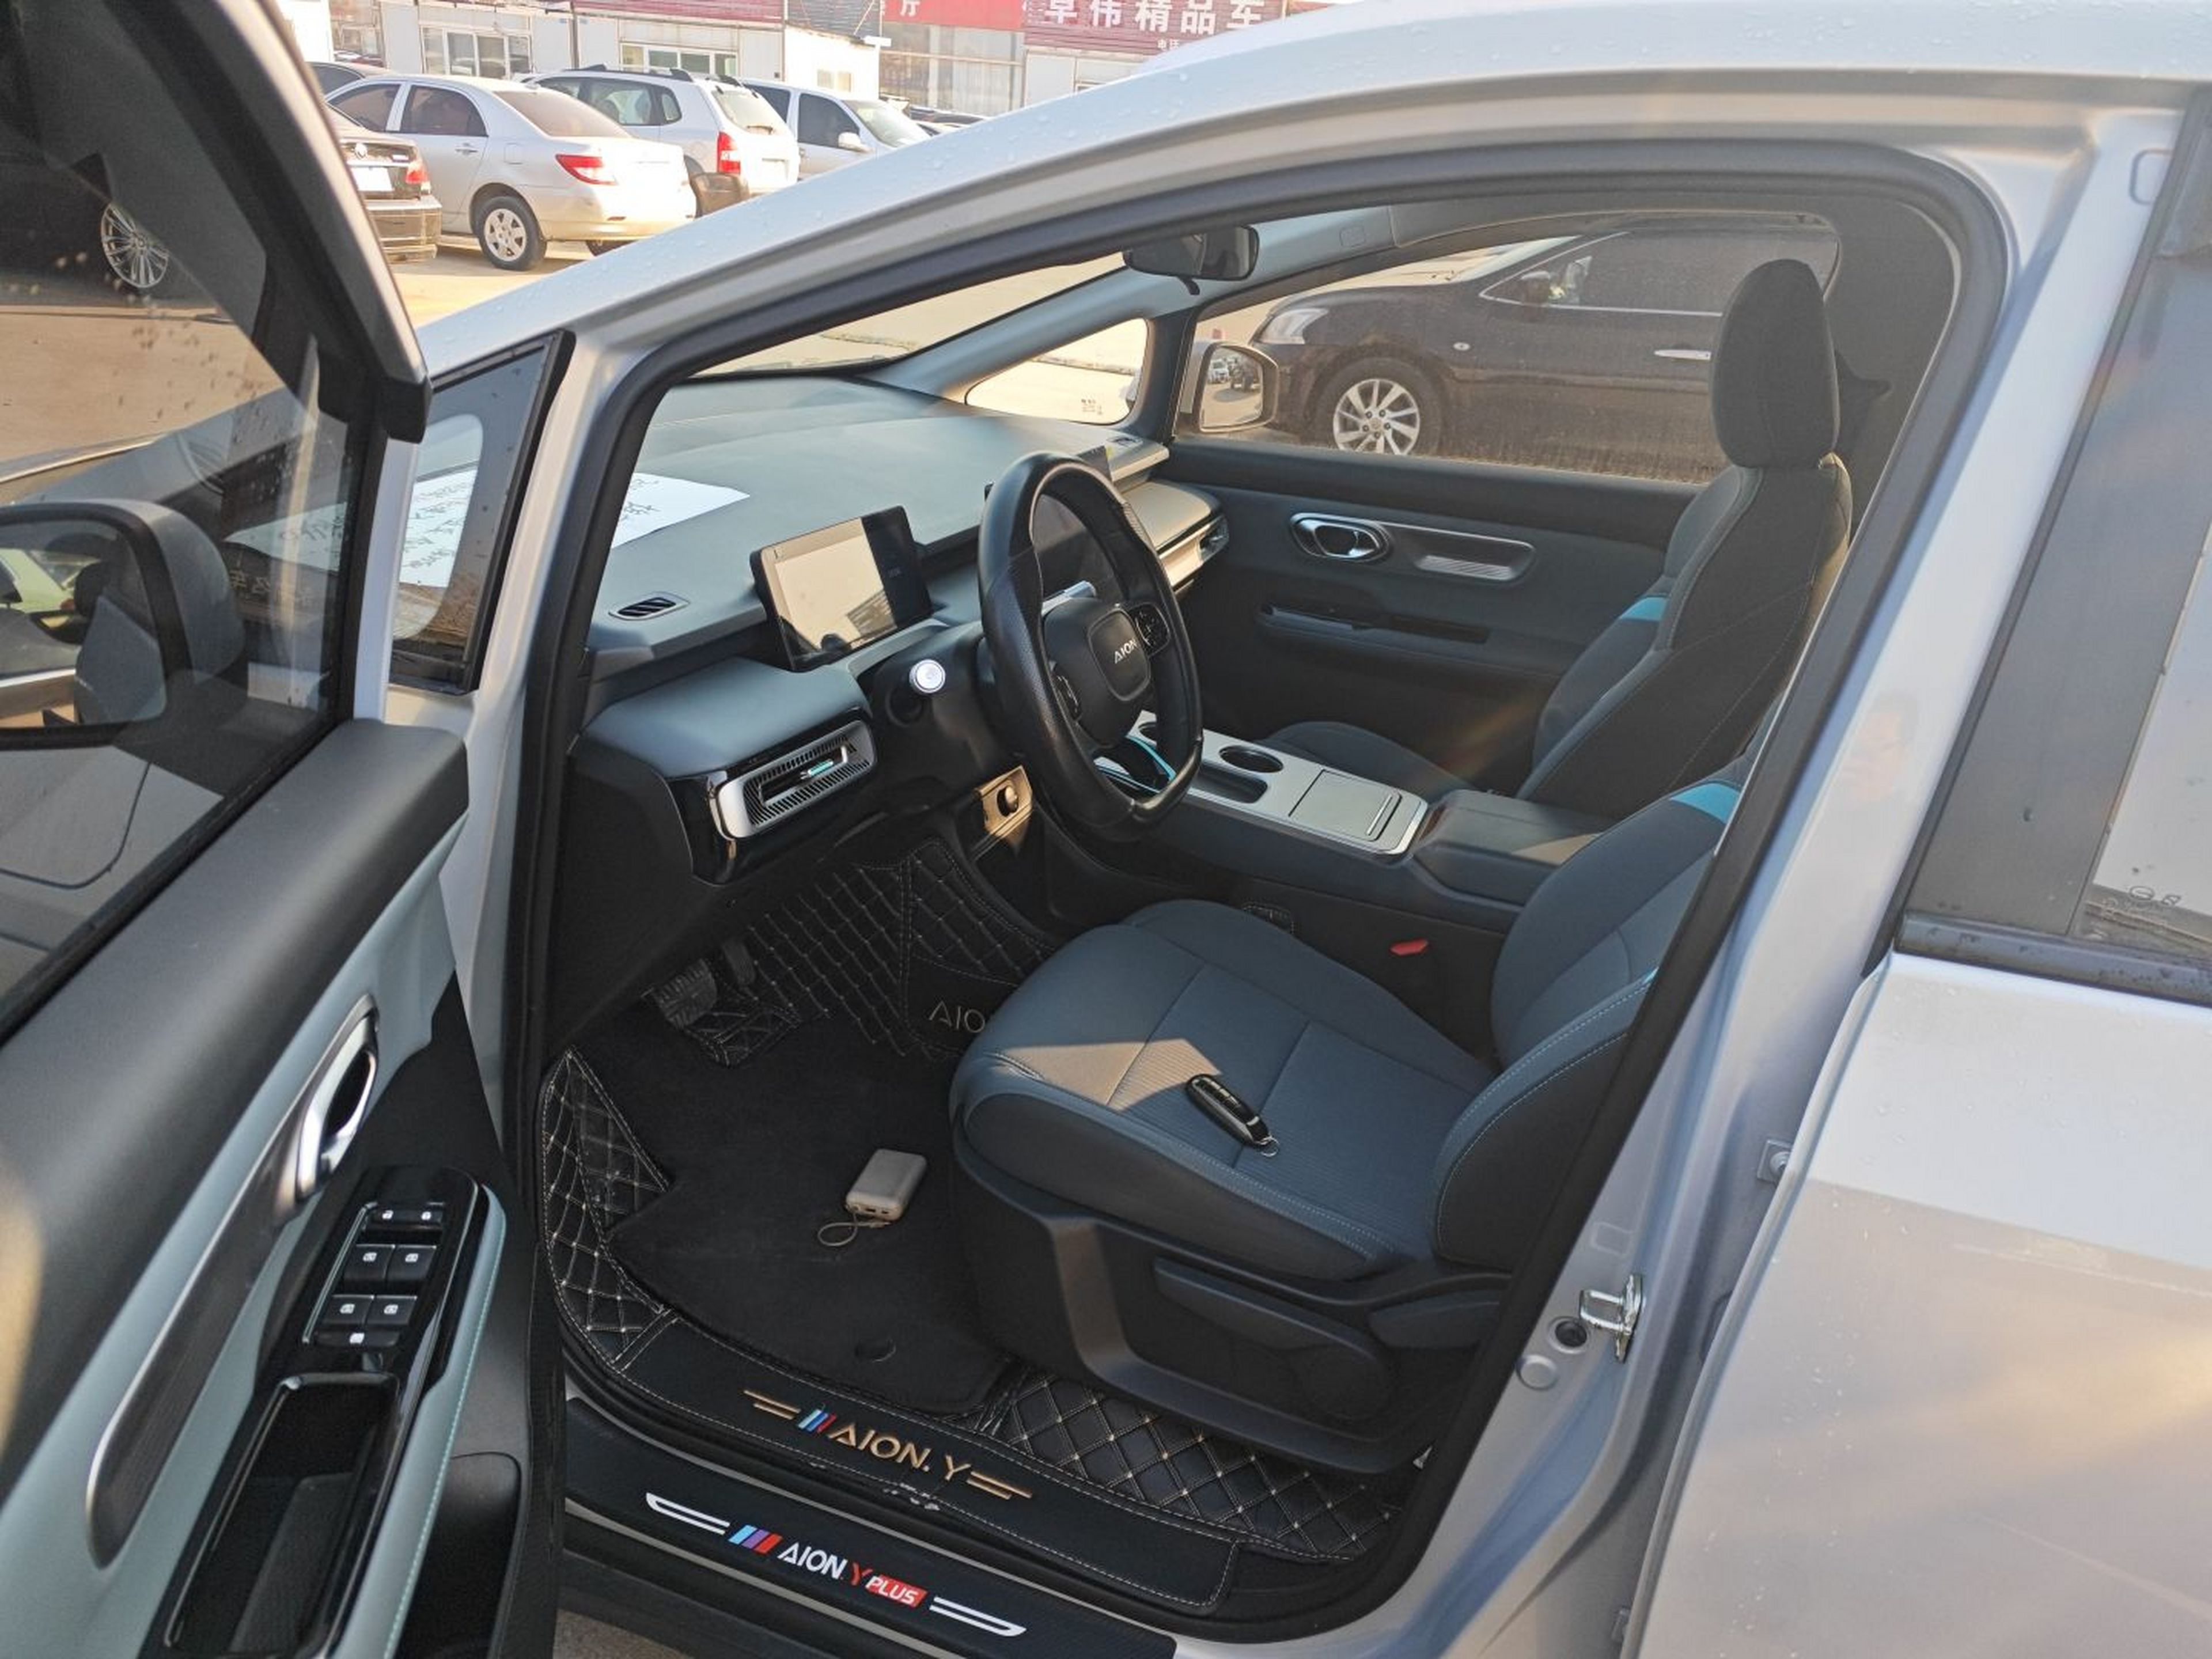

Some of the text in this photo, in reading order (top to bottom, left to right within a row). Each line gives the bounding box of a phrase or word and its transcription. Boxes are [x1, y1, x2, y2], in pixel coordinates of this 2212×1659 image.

[1114, 637, 1138, 664] AION
[945, 1455, 972, 1481] Y
[851, 1562, 874, 1586] Y
[865, 1575, 919, 1605] PLUS
